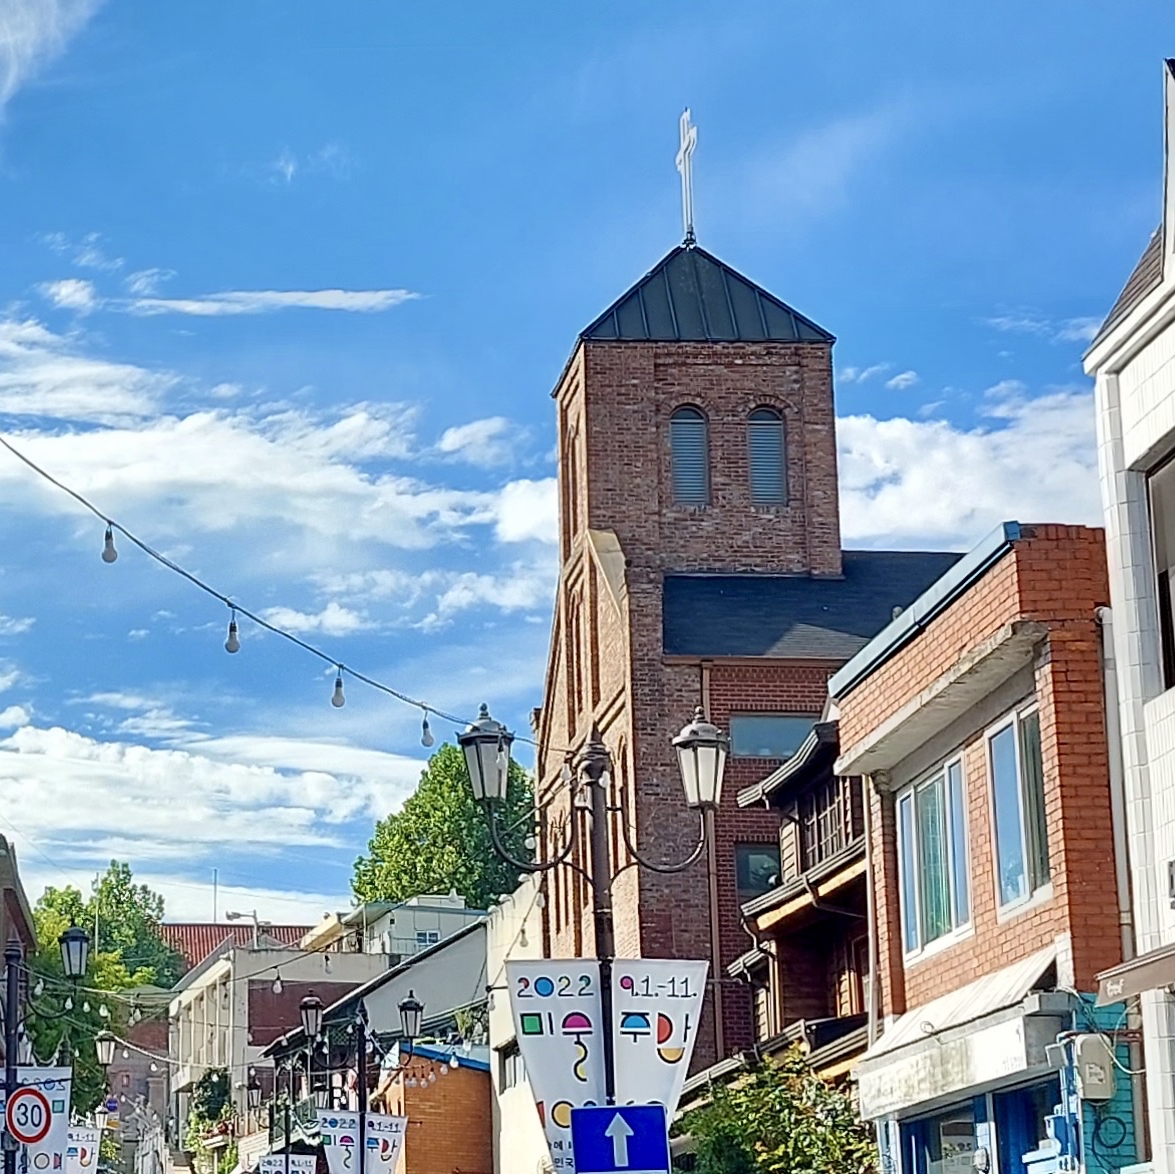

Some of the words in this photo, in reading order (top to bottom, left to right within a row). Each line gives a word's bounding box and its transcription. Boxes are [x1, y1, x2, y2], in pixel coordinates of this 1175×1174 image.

[517, 975, 594, 998] 2022
[16, 1102, 42, 1128] 30
[321, 1117, 357, 1129] 2022
